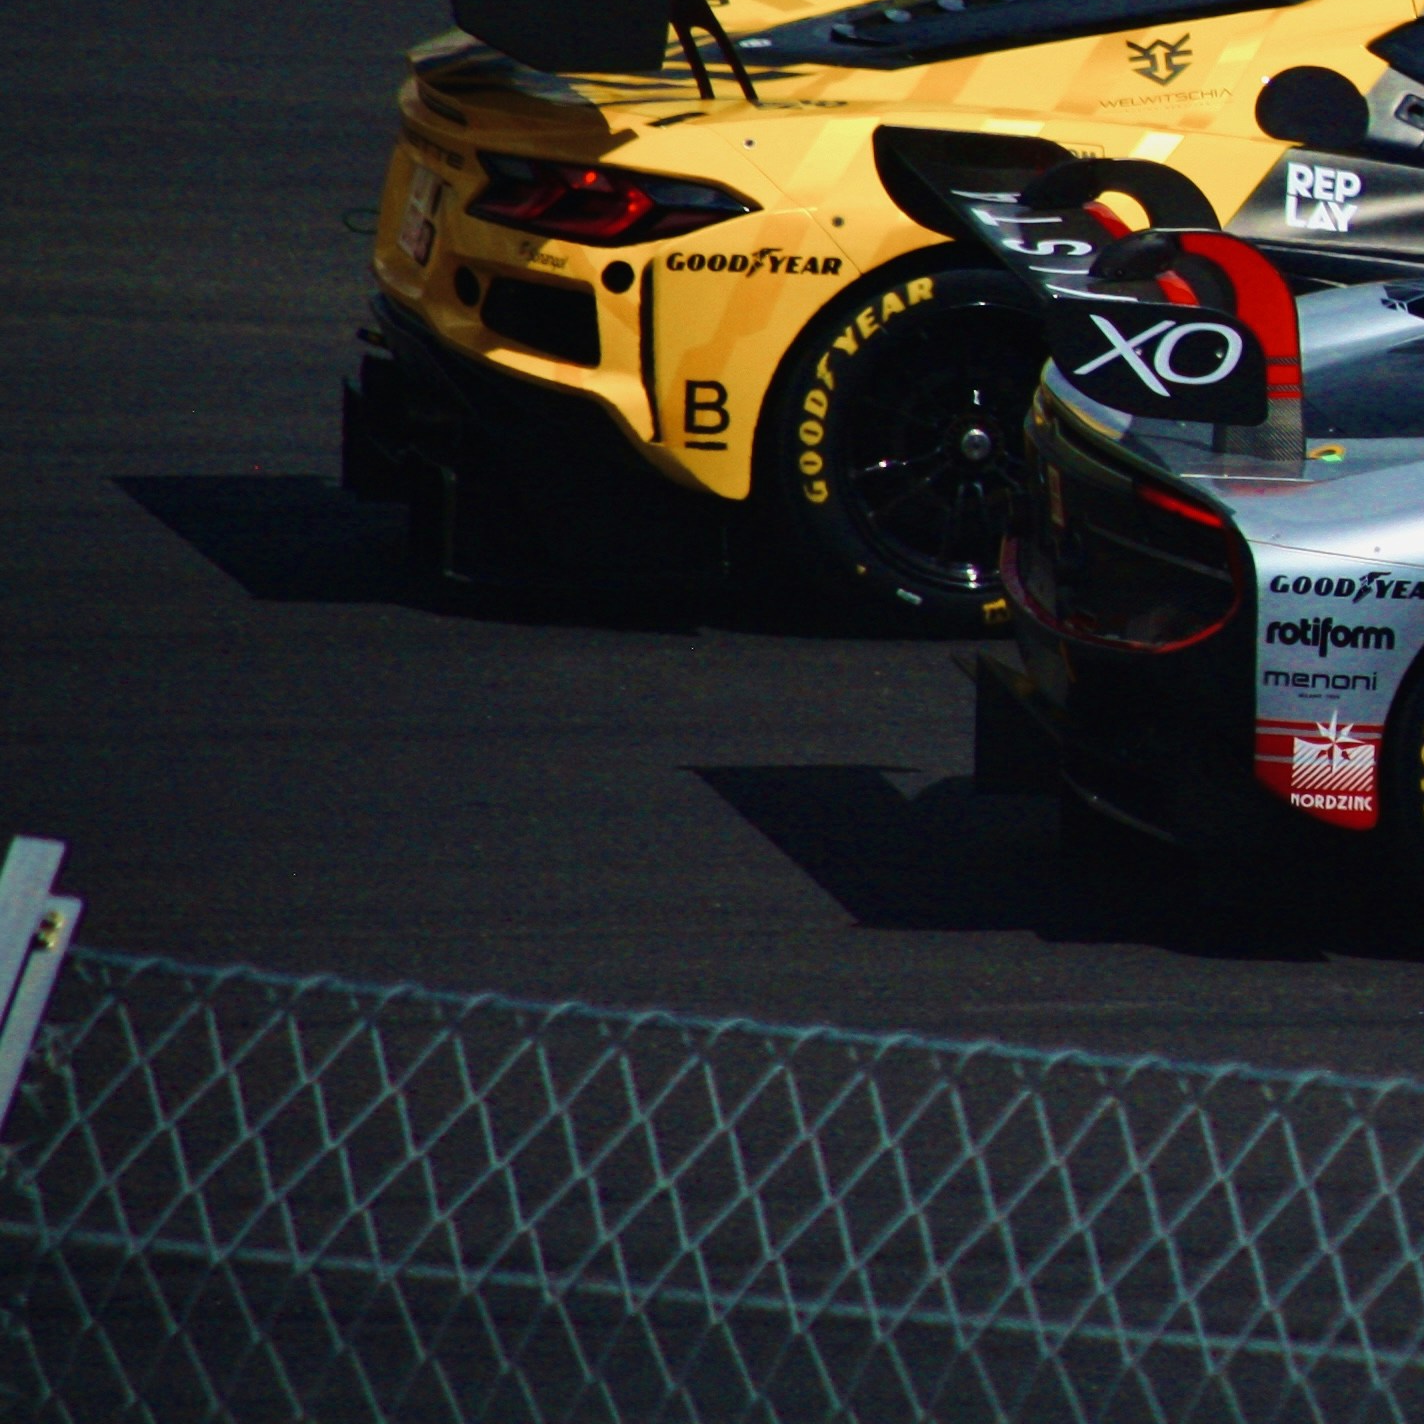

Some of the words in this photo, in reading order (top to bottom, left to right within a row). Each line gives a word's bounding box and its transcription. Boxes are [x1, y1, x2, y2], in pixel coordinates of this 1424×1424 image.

[1100, 87, 1233, 108] WELWITSCHIA
[1286, 162, 1361, 201] REP
[1286, 194, 1358, 232] LAY
[1073, 313, 1243, 397] XO
[684, 379, 730, 435] B
[1265, 617, 1396, 658] rotiform
[1263, 671, 1378, 692] menoni
[1291, 793, 1374, 812] NORDZINC
